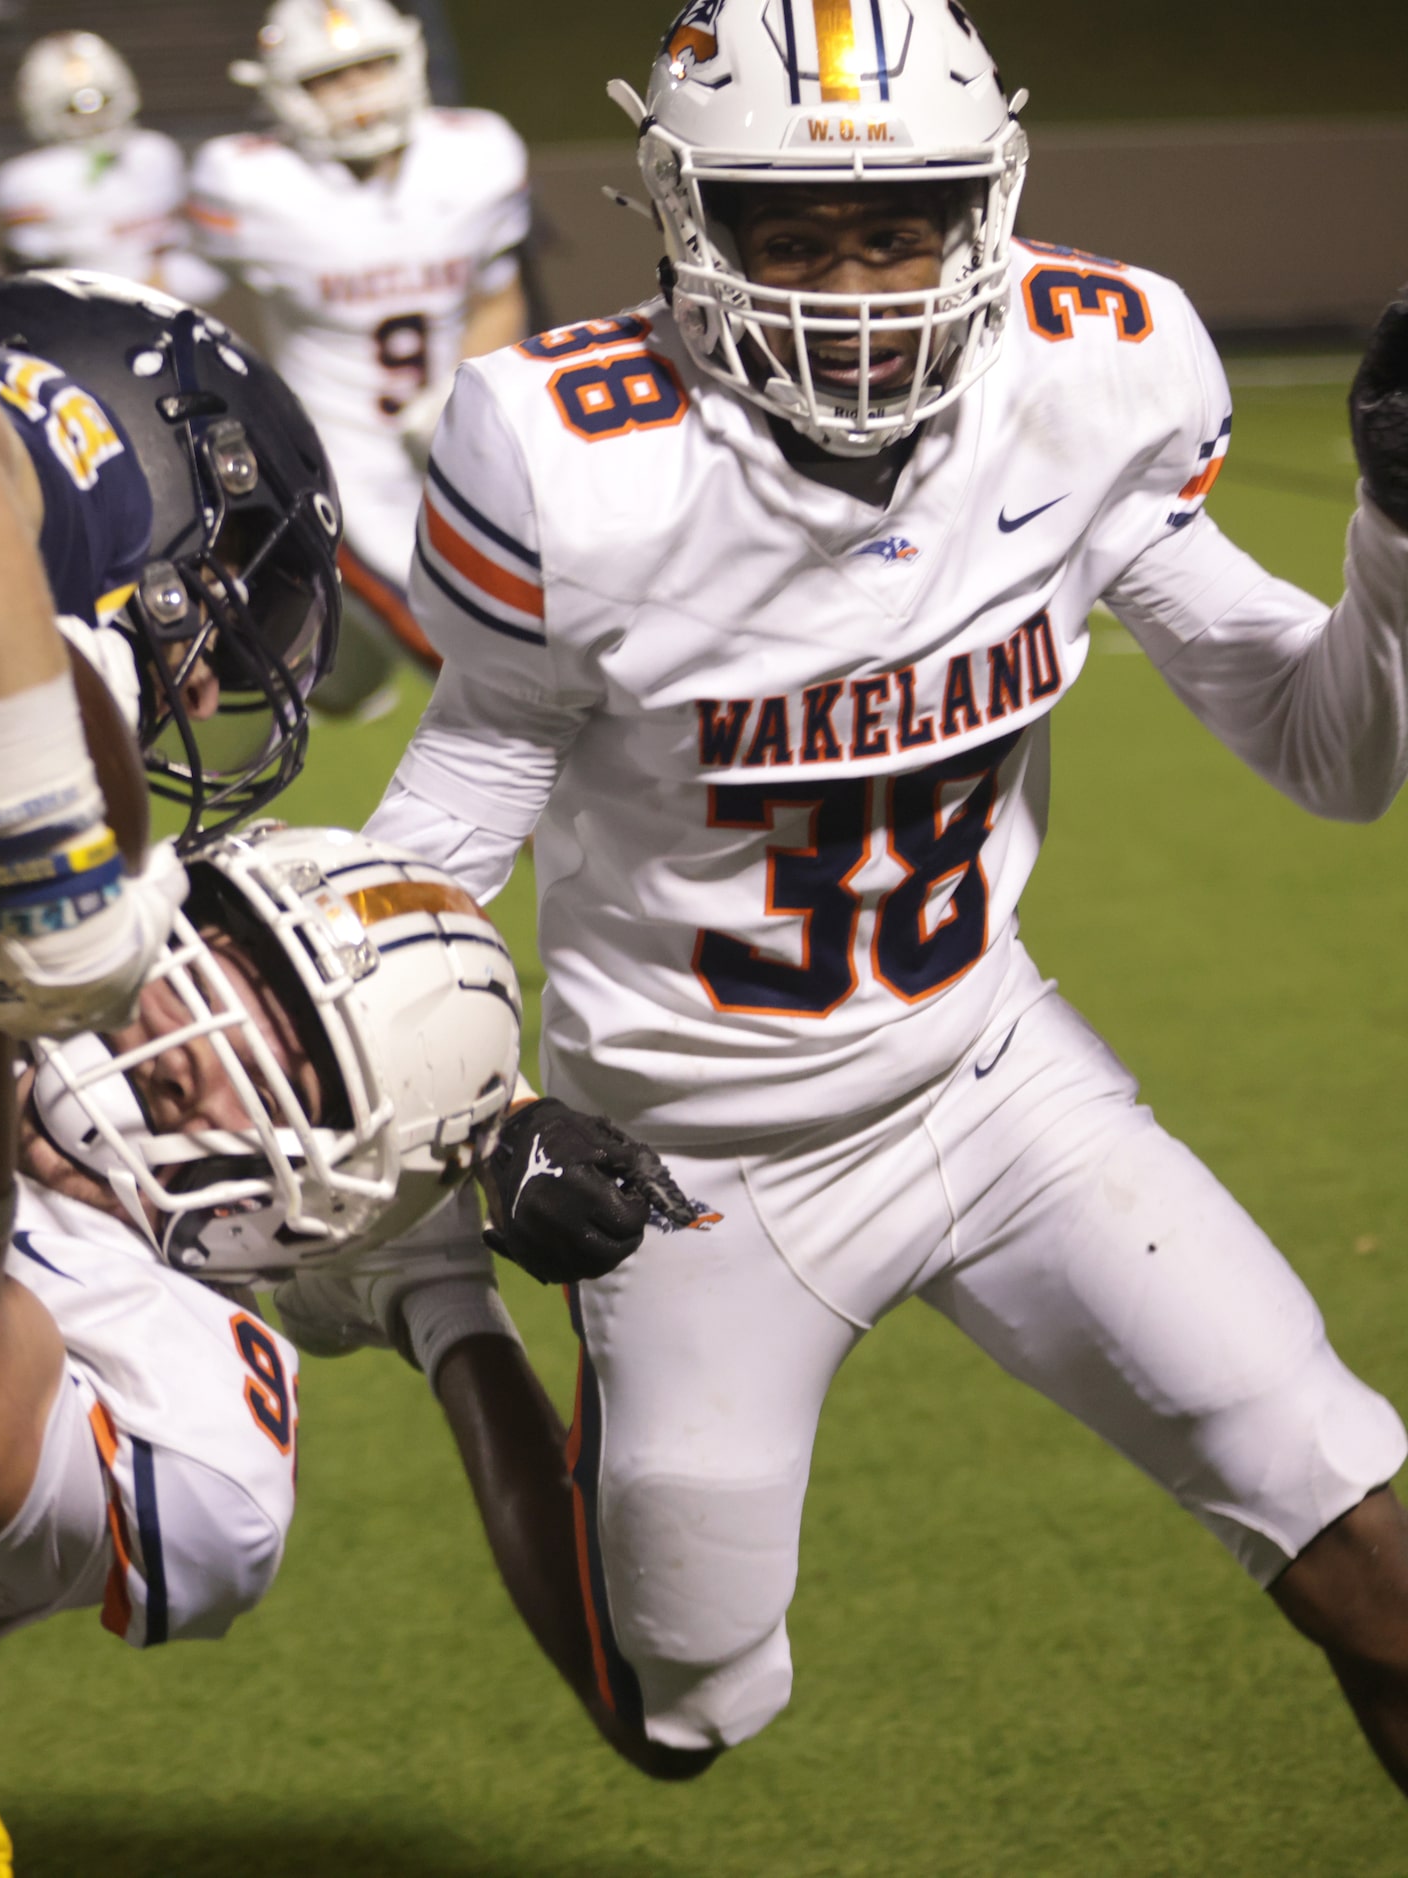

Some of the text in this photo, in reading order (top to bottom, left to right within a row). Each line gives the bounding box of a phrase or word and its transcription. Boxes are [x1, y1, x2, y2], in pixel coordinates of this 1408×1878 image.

[374, 311, 429, 418] 9
[512, 313, 690, 443] 38
[834, 406, 885, 419] Ridell
[696, 609, 1063, 768] WAKELAND
[691, 727, 1026, 1019] 38
[228, 1311, 298, 1460] 9
